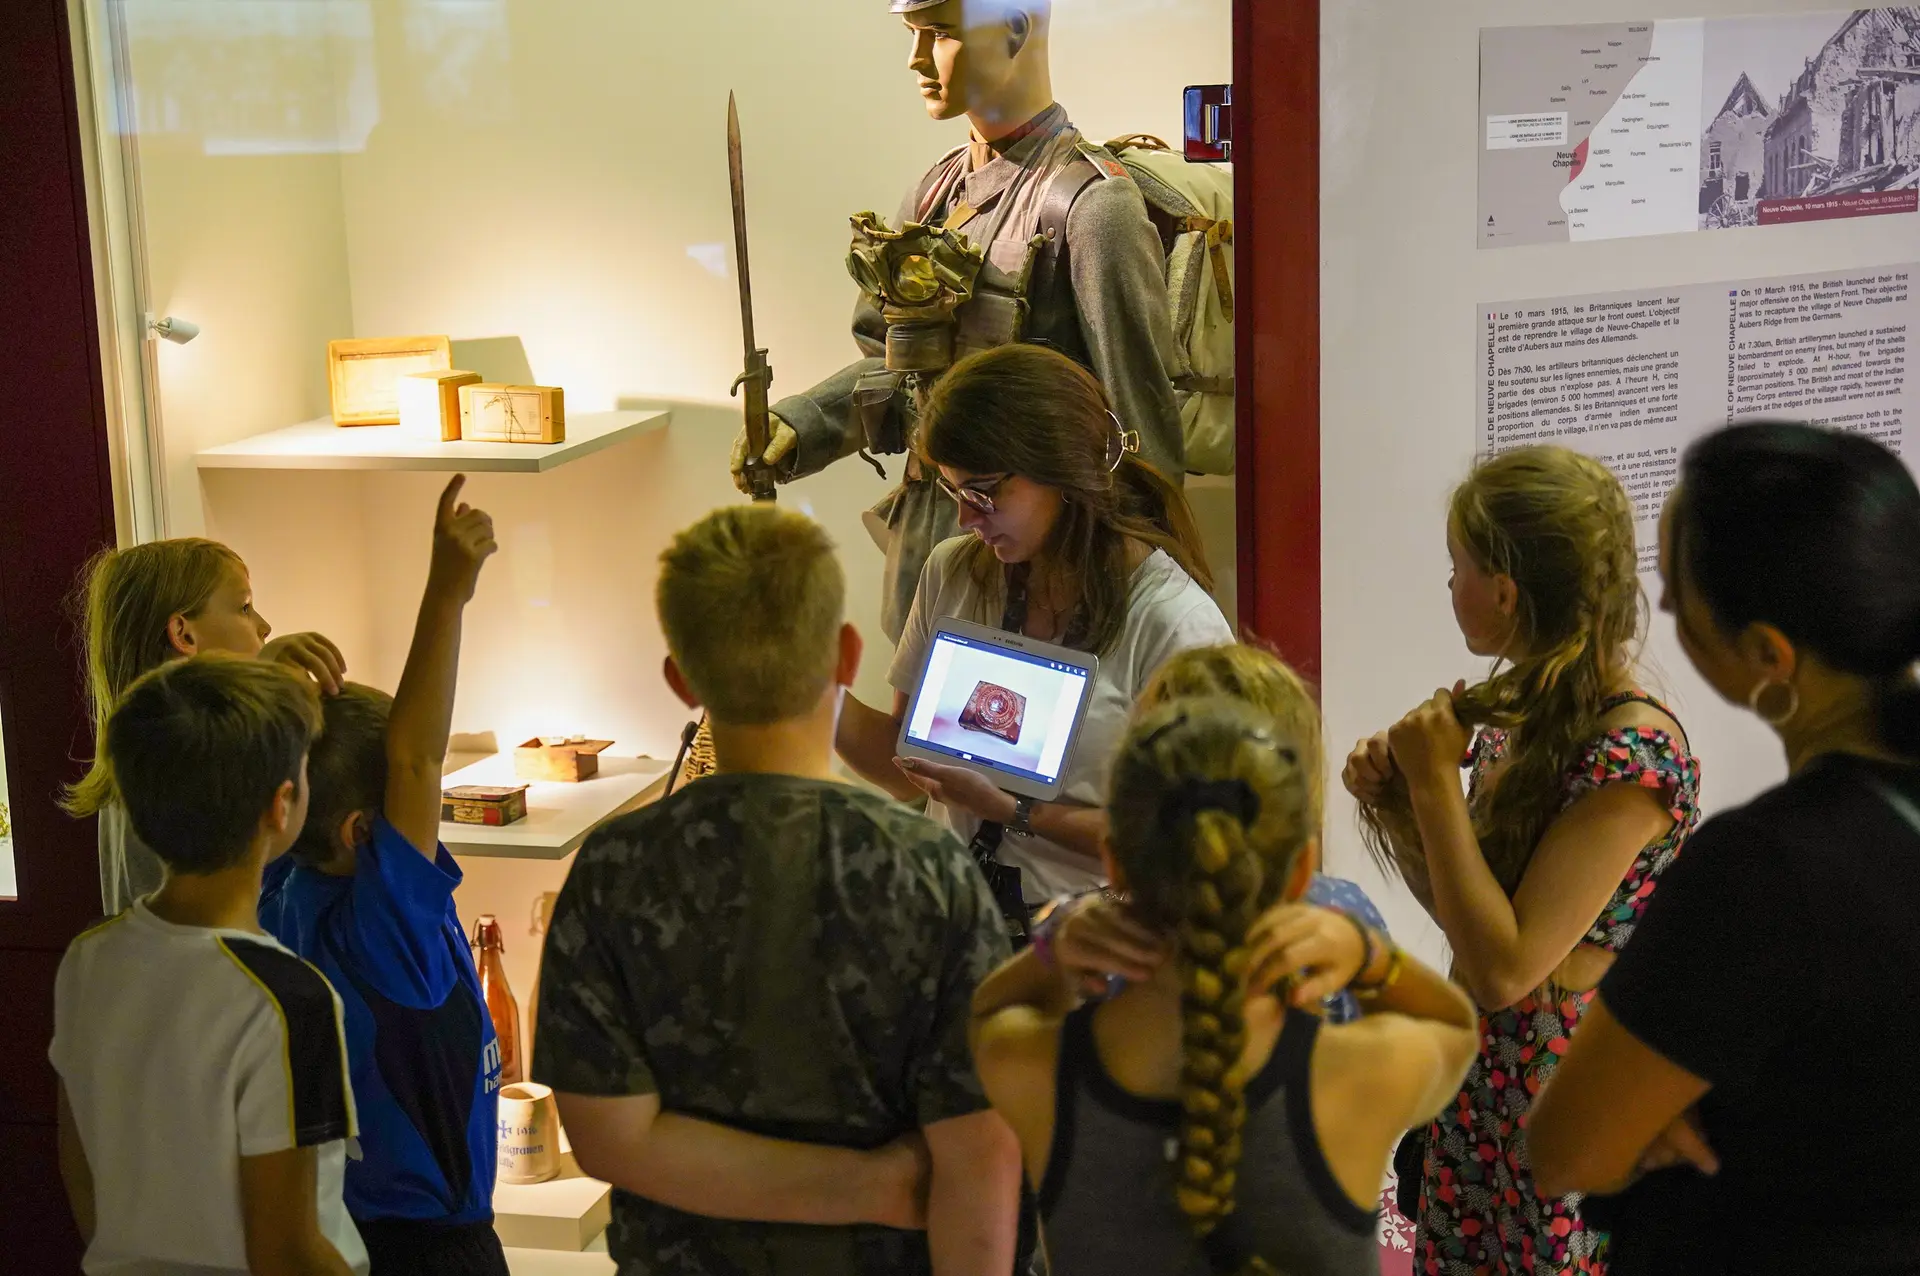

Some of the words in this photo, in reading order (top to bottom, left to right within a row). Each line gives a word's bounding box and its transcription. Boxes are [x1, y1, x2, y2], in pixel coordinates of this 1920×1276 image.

[1780, 204, 1804, 212] Chapelle,
[1739, 300, 1758, 310] major
[1760, 295, 1790, 306] offensive
[1801, 293, 1812, 302] the
[1814, 290, 1840, 301] Western
[1863, 287, 1878, 296] Their
[1879, 284, 1908, 296] objective
[1741, 288, 1751, 297] On
[1754, 287, 1762, 296] 10
[1765, 285, 1786, 295] March
[1809, 282, 1819, 291] the
[1823, 280, 1844, 289] British
[1846, 277, 1875, 287] launched
[1878, 275, 1892, 284] their
[1896, 274, 1908, 282] first
[1500, 312, 1509, 320] Le
[1515, 310, 1523, 319] 10
[1528, 310, 1546, 318] mars
[1574, 305, 1584, 314] les
[1590, 301, 1632, 314] Britanniques
[1637, 298, 1662, 308] lancent
[1667, 296, 1680, 305] leur
[1755, 309, 1762, 317] to
[1765, 305, 1796, 318] recapture
[1798, 304, 1809, 313] the
[1811, 302, 1832, 313] village
[1834, 301, 1841, 309] of
[1843, 299, 1863, 308] Neuve
[1866, 296, 1893, 308] Chapelle
[1896, 294, 1907, 304] and
[1498, 321, 1530, 334] première
[1531, 319, 1556, 331] grande
[1558, 316, 1584, 328] attaque
[1599, 314, 1606, 323] le
[1608, 313, 1624, 322] front
[1498, 334, 1509, 343] est
[1512, 333, 1522, 342] de
[1524, 330, 1558, 342] reprendre
[1561, 329, 1568, 337] le
[1570, 326, 1593, 338] village
[1596, 325, 1604, 334] de
[1664, 319, 1670, 327] et
[1674, 318, 1679, 326] la
[1739, 319, 1762, 329] Aubers
[1764, 317, 1783, 328] Ridge
[1784, 316, 1799, 325] from
[1801, 315, 1811, 324] the
[1498, 344, 1516, 354] crête
[1565, 338, 1585, 348] mains
[1587, 337, 1600, 346] des
[1738, 342, 1746, 350] At
[1776, 337, 1797, 346] British
[1799, 332, 1837, 346] artillerymen
[1838, 329, 1868, 340] launched
[1876, 325, 1906, 336] sustained
[1738, 348, 1784, 361] bombardment
[1795, 346, 1817, 356] enemy
[1836, 342, 1847, 350] but
[1849, 341, 1866, 351] many
[1868, 339, 1874, 347] of
[1876, 338, 1886, 346] the
[1887, 335, 1906, 345] shells
[1498, 367, 1512, 376] Dès
[1536, 364, 1546, 372] les
[1549, 360, 1579, 371] artilleurs
[1582, 356, 1624, 370] britanniques
[1626, 352, 1668, 364] déclenchent
[1498, 378, 1509, 387] feu
[1511, 375, 1539, 386] soutenu
[1553, 373, 1563, 382] les
[1565, 371, 1586, 382] lignes
[1623, 365, 1640, 375] mais
[1655, 361, 1679, 373] grande
[1498, 389, 1518, 400] partie
[1522, 387, 1535, 396] des
[1539, 385, 1556, 394] obus
[1664, 372, 1678, 383] cinq
[1498, 399, 1528, 411] brigades
[1568, 393, 1581, 402] 000
[1584, 390, 1615, 402] hommes)
[1618, 386, 1649, 397] avancent
[1668, 383, 1678, 392] les
[1728, 390, 1734, 402] OF
[1488, 417, 1494, 430] DE
